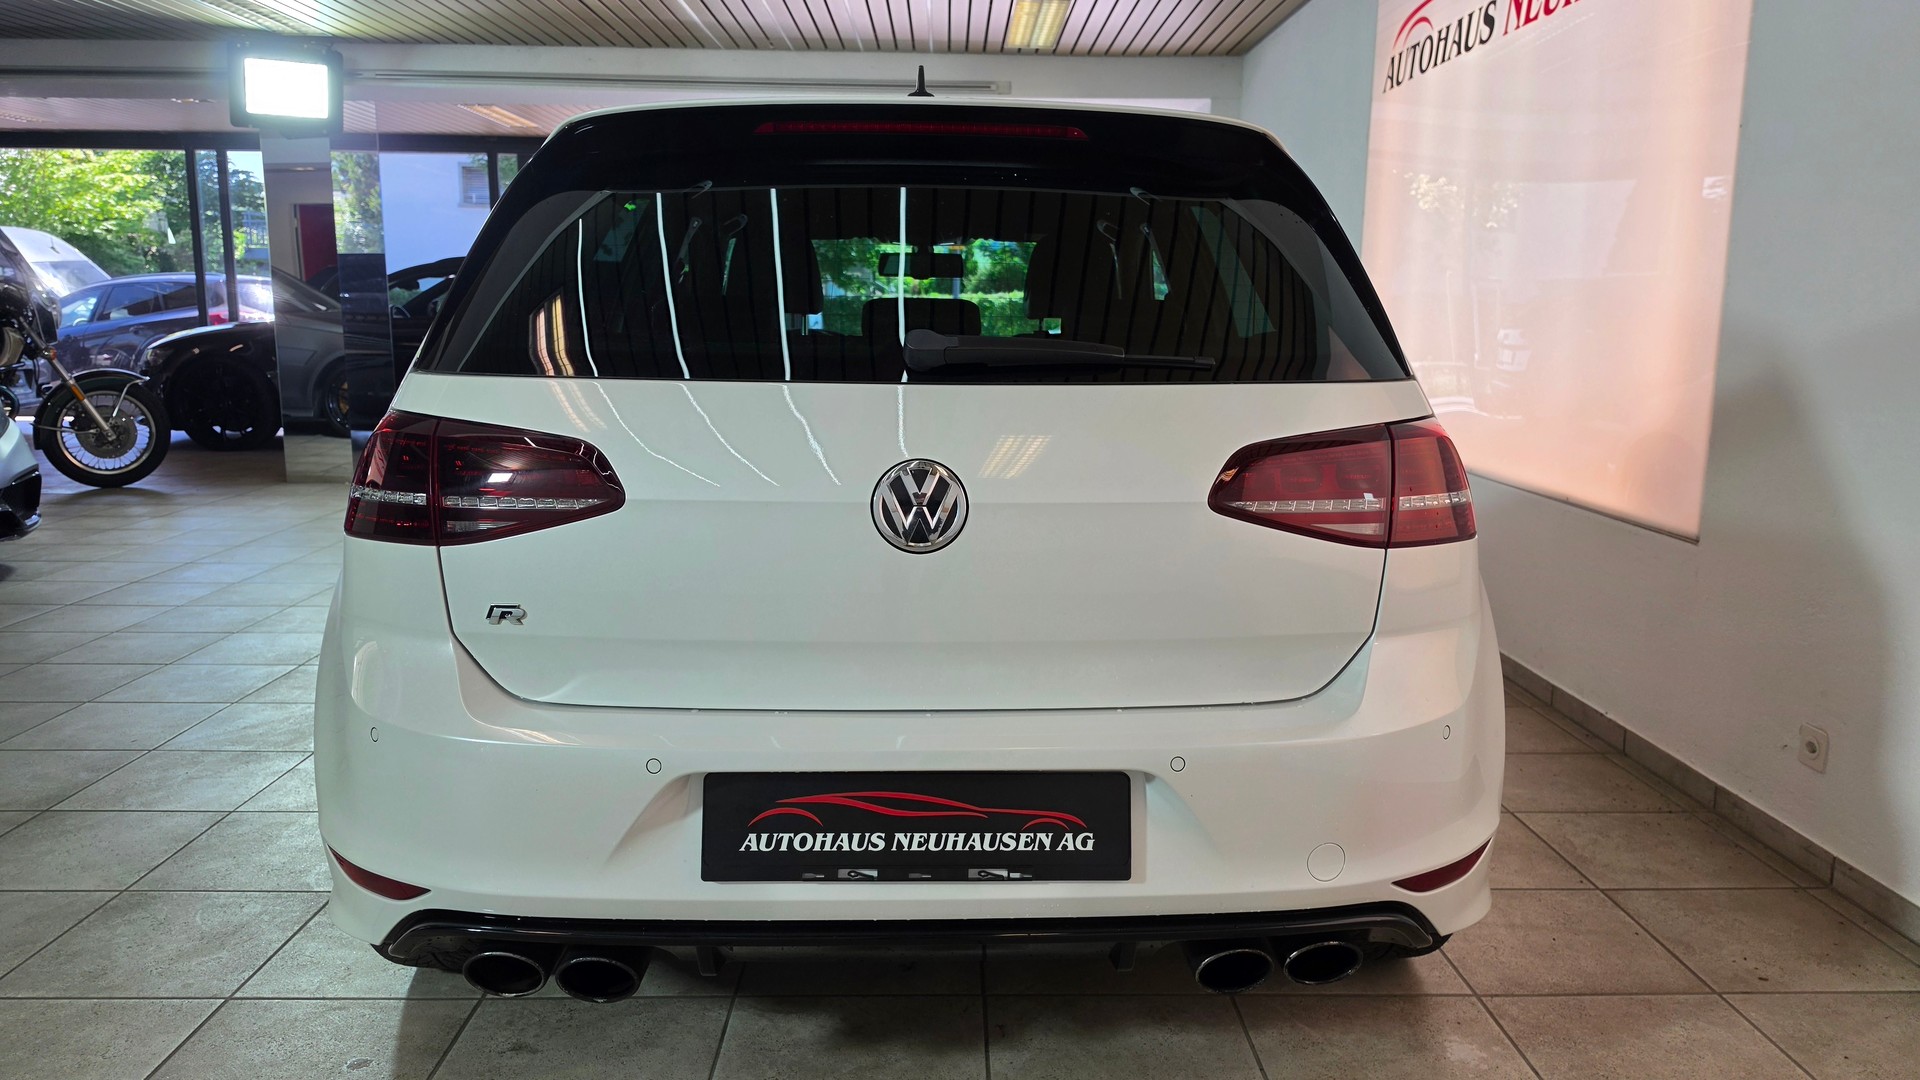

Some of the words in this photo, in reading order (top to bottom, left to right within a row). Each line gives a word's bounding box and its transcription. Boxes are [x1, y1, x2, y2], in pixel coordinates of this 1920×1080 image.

[1382, 0, 1497, 93] AUTOHAUS
[1502, 0, 1582, 36] NE
[878, 463, 962, 547] VW
[485, 603, 528, 625] R
[738, 832, 886, 852] AUTOHAUS
[891, 832, 1053, 852] NEUHAUSEN
[1056, 832, 1095, 852] AG
